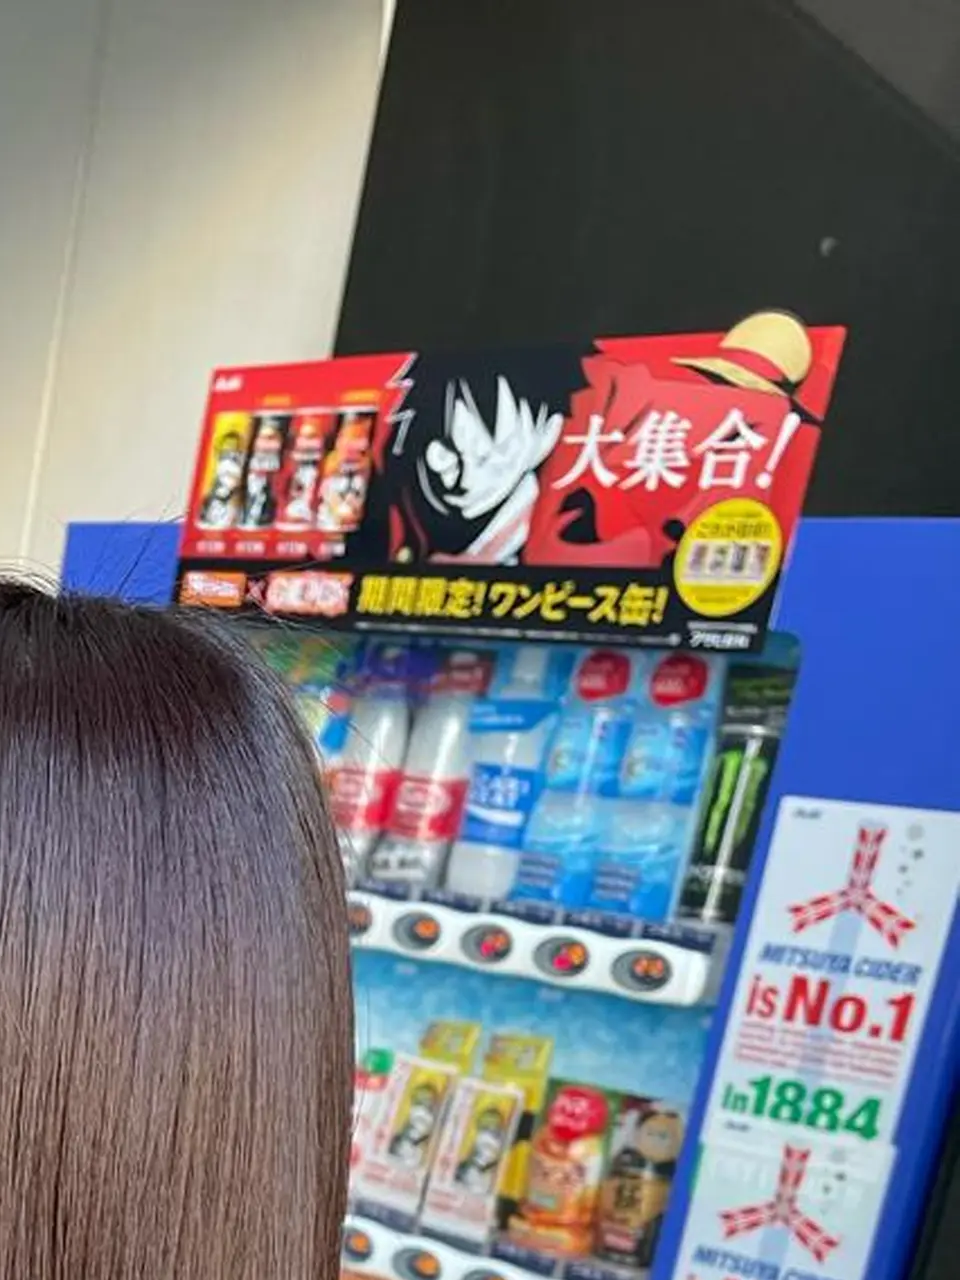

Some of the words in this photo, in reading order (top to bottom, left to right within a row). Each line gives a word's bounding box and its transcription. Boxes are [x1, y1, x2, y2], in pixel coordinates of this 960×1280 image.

[551, 408, 801, 490] 大集合!
[759, 943, 852, 973] MITSUYA
[854, 957, 922, 985] CIDER
[746, 974, 778, 1018] is
[783, 974, 915, 1042] No.1
[748, 1075, 881, 1141] 1884
